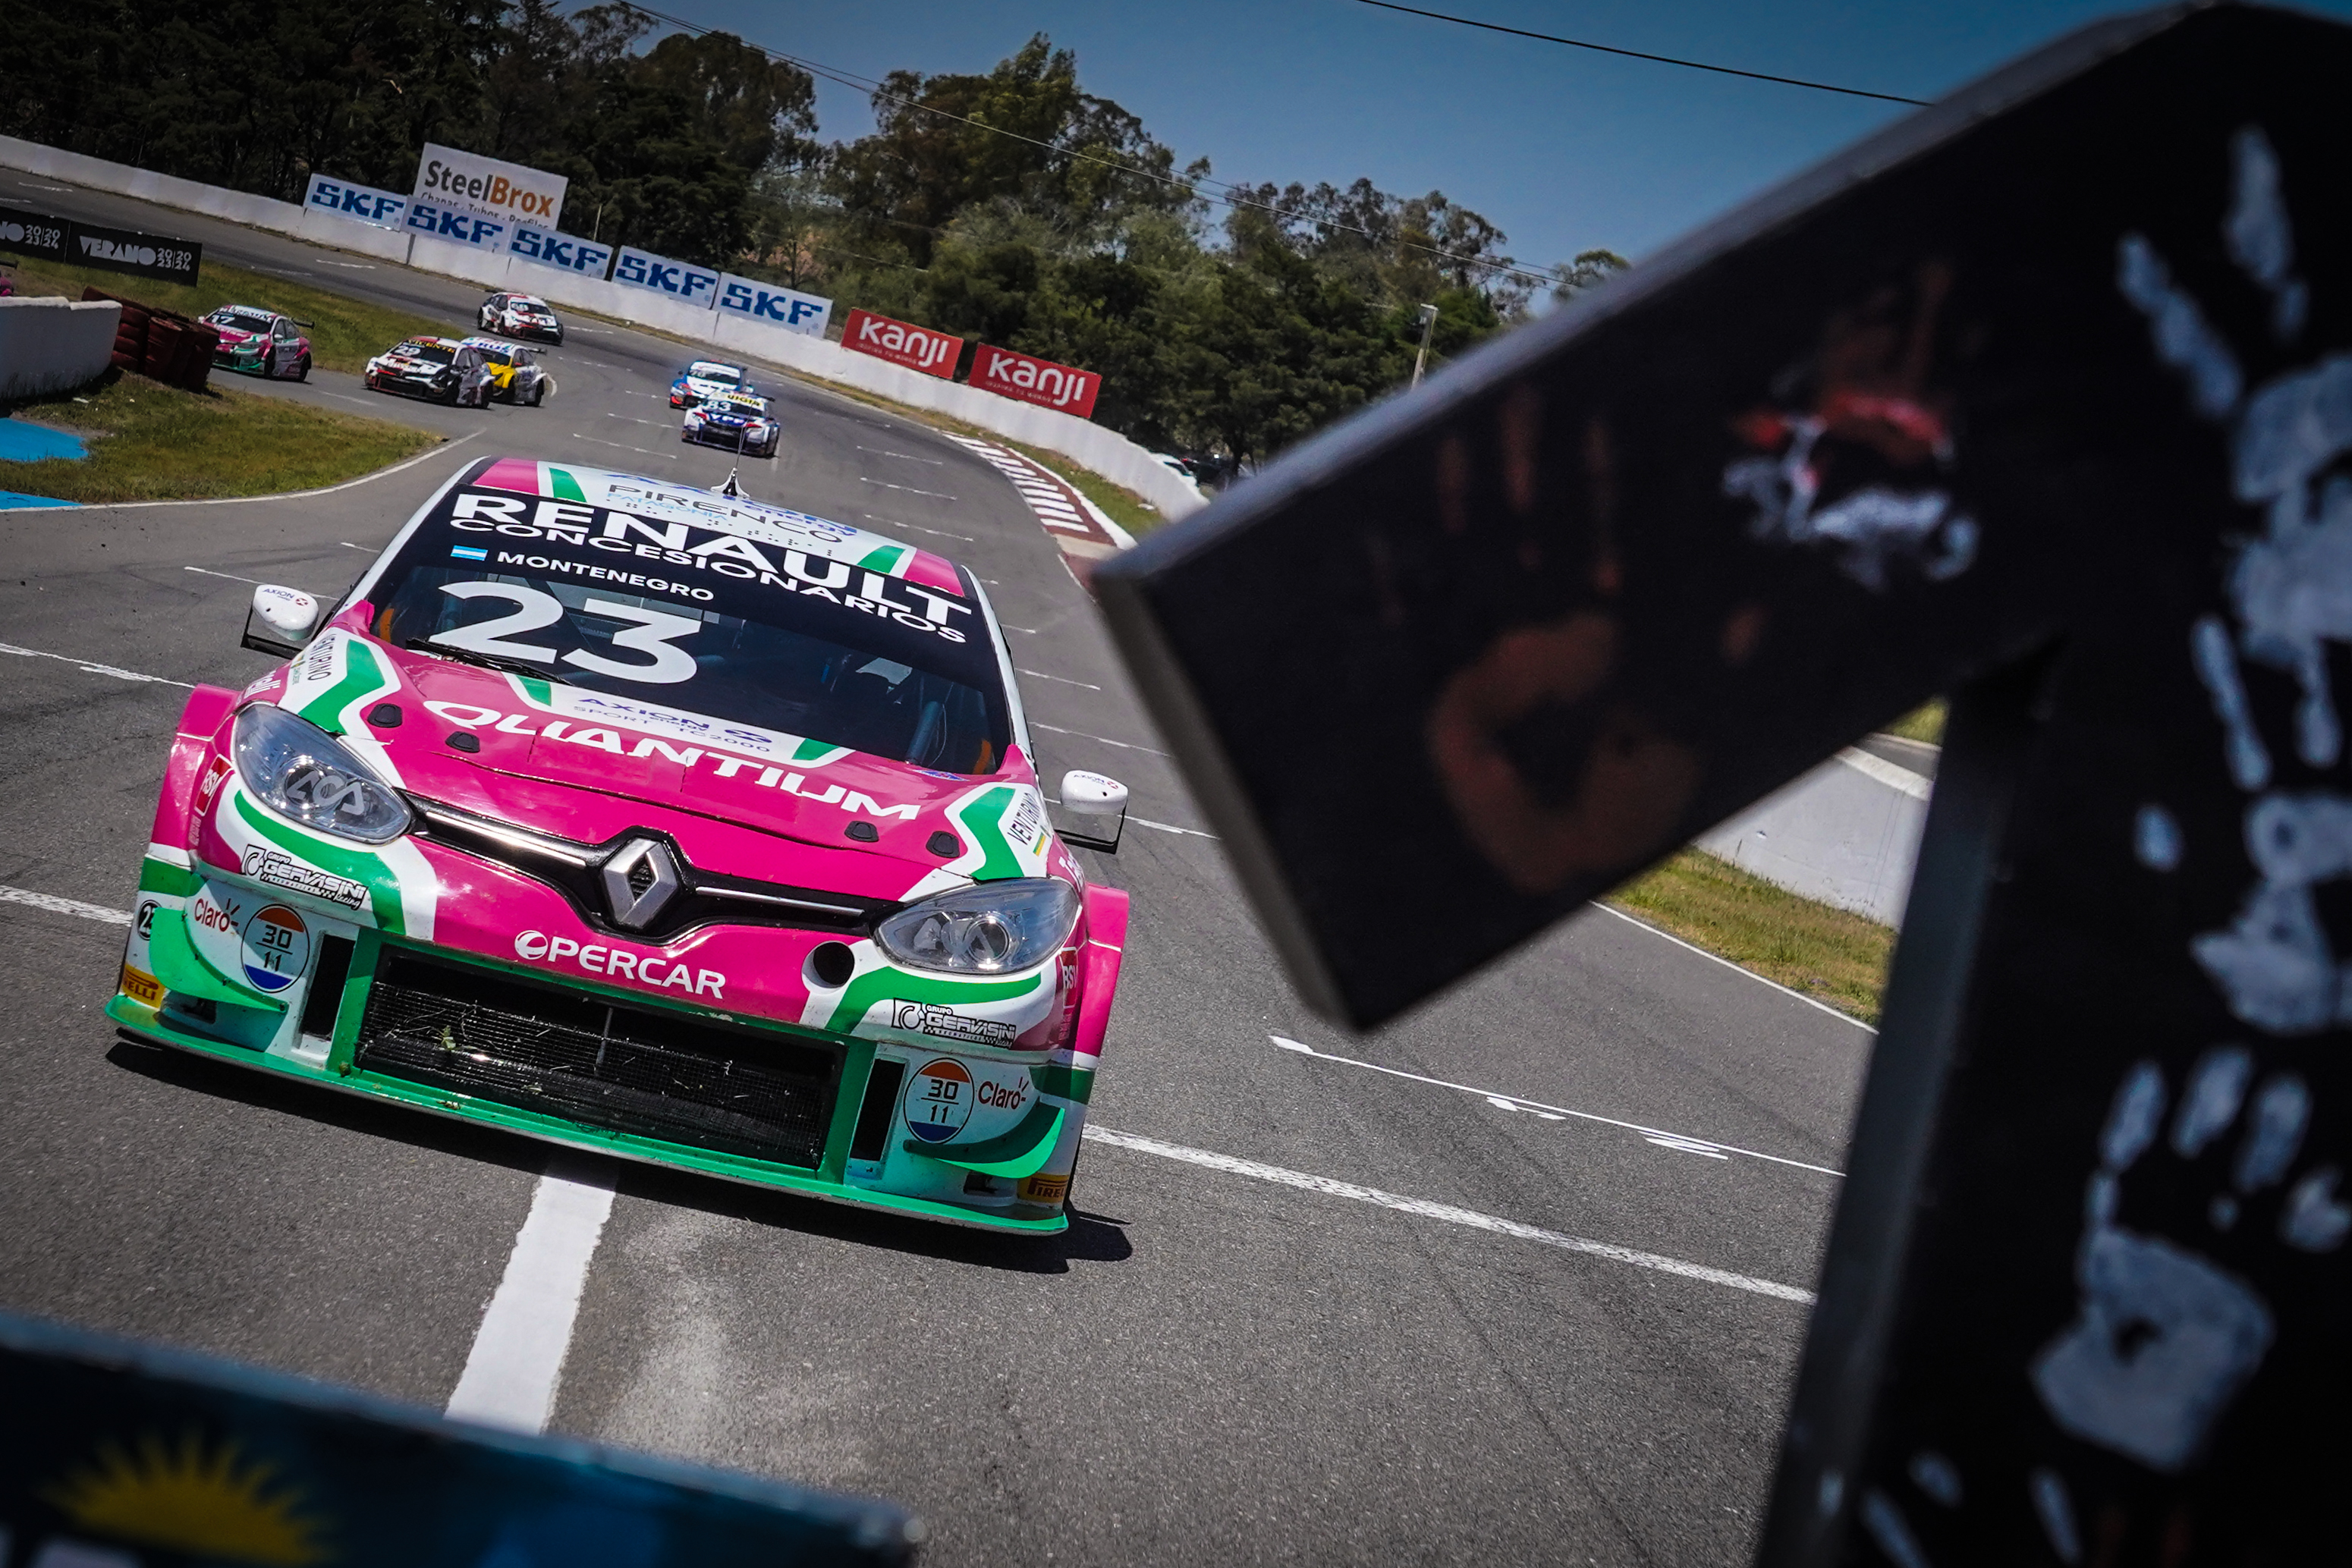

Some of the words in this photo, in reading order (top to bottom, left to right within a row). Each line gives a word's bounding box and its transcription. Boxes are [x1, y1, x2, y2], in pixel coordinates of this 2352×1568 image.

[311, 182, 405, 219] SKF
[424, 160, 555, 218] SteelBrox
[407, 204, 503, 244] SKF
[79, 236, 156, 266] VERANO
[511, 229, 608, 270] SKF
[615, 255, 715, 297] SKF
[211, 314, 235, 324] 17
[721, 283, 823, 325] SKF
[395, 345, 421, 357] 29
[707, 400, 731, 412] 83
[608, 493, 728, 521] PATAGONIA
[609, 484, 842, 543] PIRENCO
[453, 494, 972, 625] RENAULT
[497, 551, 715, 601] MONTENEGRO
[263, 588, 295, 599] AXION
[450, 518, 967, 643] CONCESIONARIOS
[428, 581, 697, 683] 23
[574, 706, 653, 724] SPORT
[677, 727, 770, 752] TC2000
[578, 698, 709, 728] AXION
[423, 700, 921, 820] QUANTIUM
[266, 852, 291, 864] GRUPO
[263, 859, 368, 900] GERVASINI
[194, 897, 230, 932] Claro
[262, 924, 292, 949] 30
[264, 951, 282, 972] 11
[547, 936, 726, 999] PERCAR
[926, 1005, 952, 1015] GRUPO
[926, 1013, 1015, 1039] GERVASINI
[928, 1079, 959, 1100] 30
[978, 1081, 1021, 1110] Claro
[930, 1105, 948, 1123] 11
